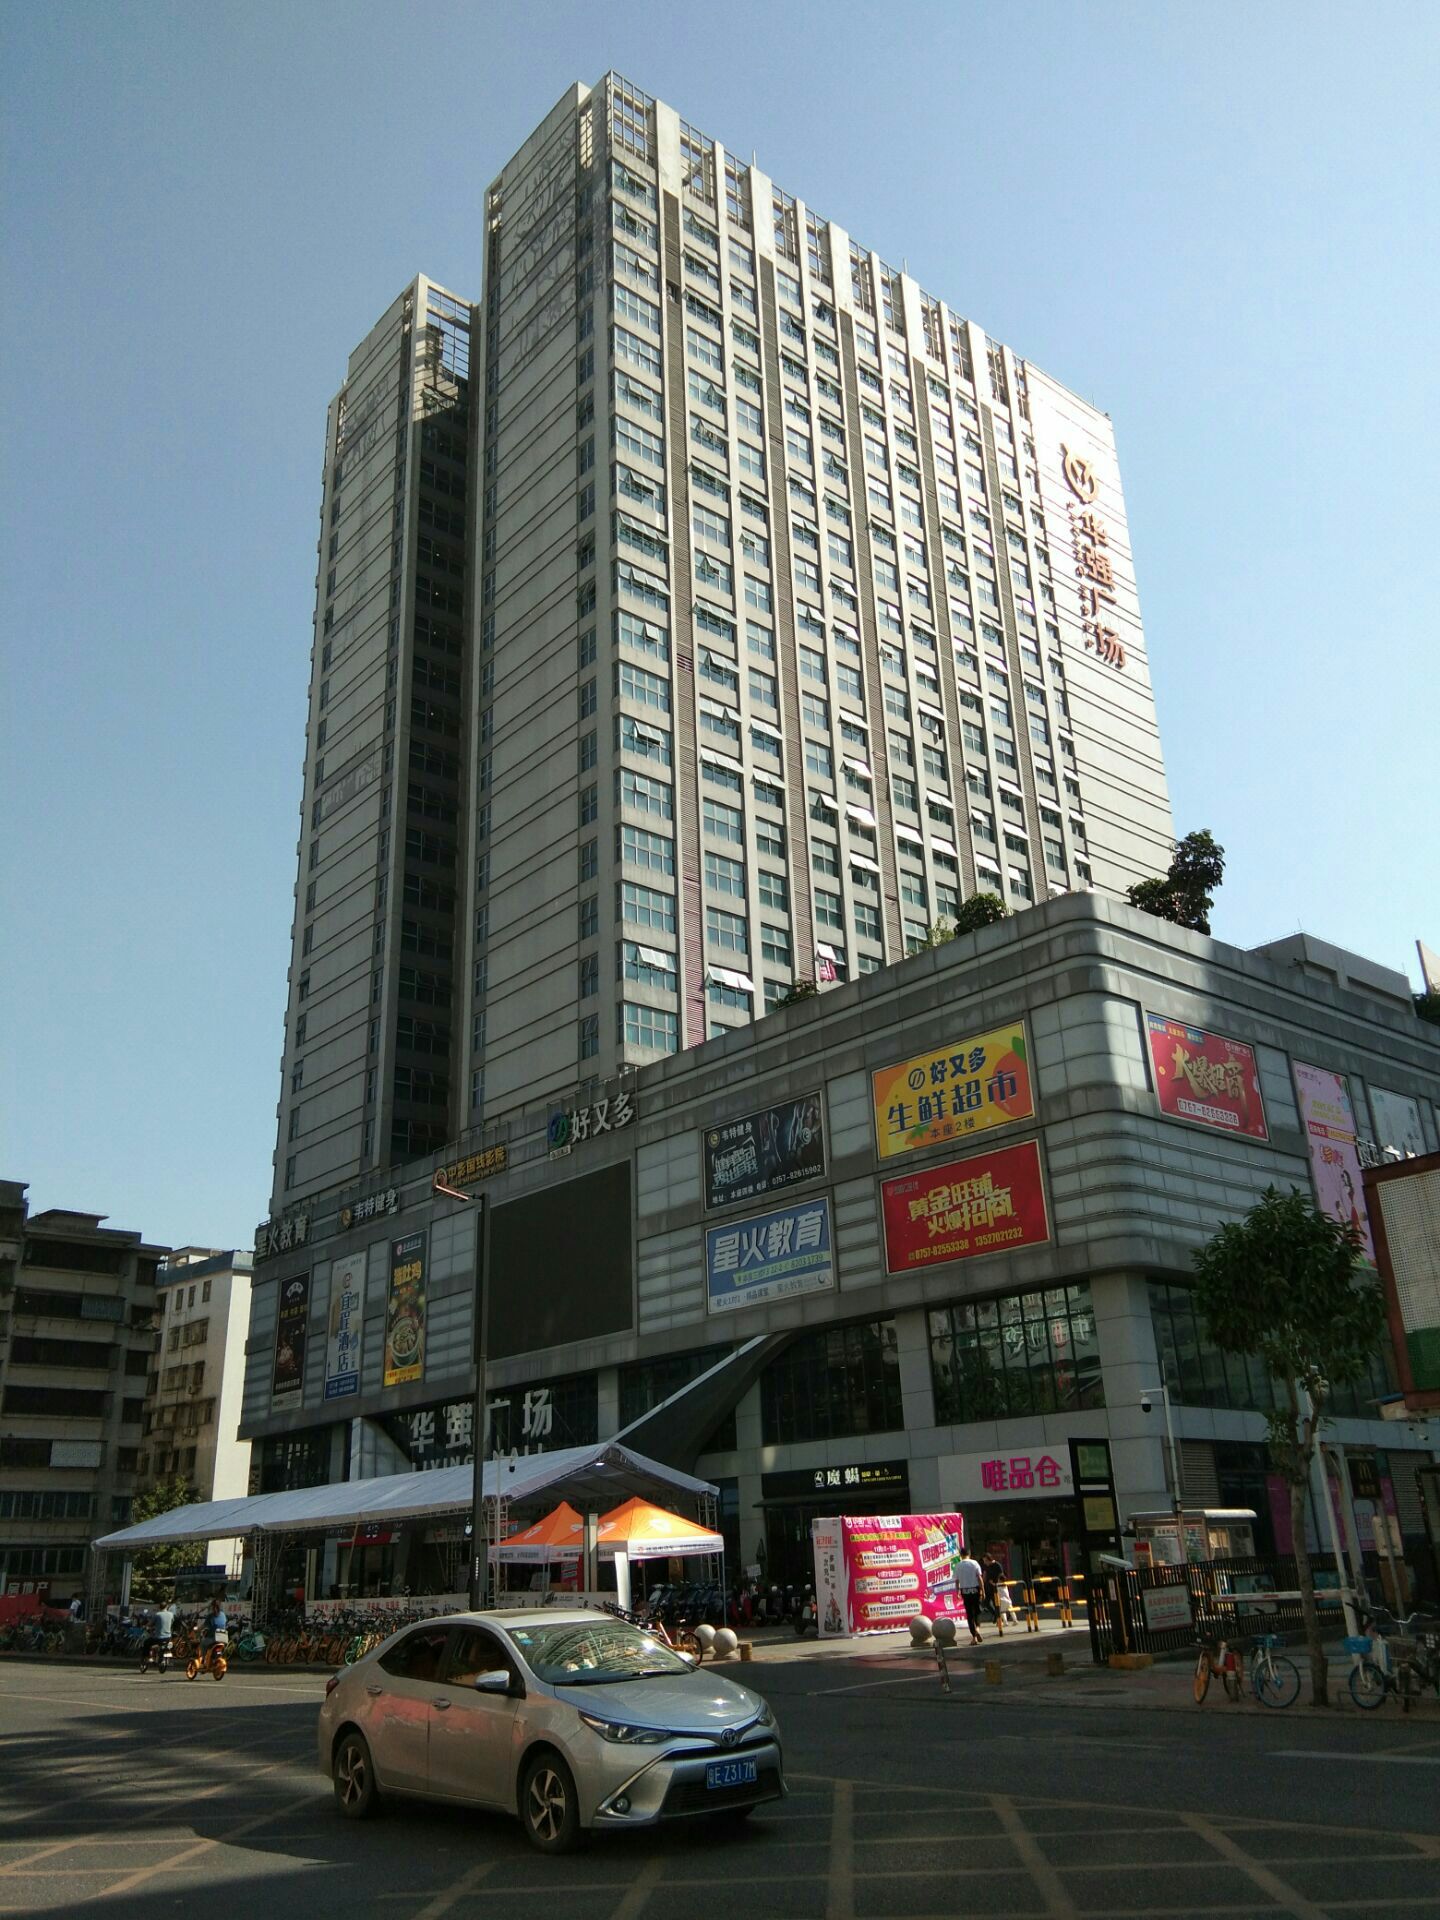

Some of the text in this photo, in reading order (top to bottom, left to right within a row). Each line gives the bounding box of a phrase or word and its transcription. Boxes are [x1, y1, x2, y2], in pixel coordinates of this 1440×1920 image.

[1078, 511, 1126, 669] 华强广场
[930, 1047, 986, 1085] 好又多
[1170, 1042, 1249, 1122] 火爆招商
[571, 1092, 635, 1142] 好又多
[888, 1070, 1017, 1135] 生鲜超市
[908, 1172, 993, 1221] 黄金旺铺
[928, 1186, 1013, 1238] 火爆招商
[255, 1214, 308, 1259] 星火教育
[713, 1210, 824, 1273] 星火教育
[409, 1388, 553, 1454] 华强广场
[981, 1455, 1062, 1492] 唯品仓
